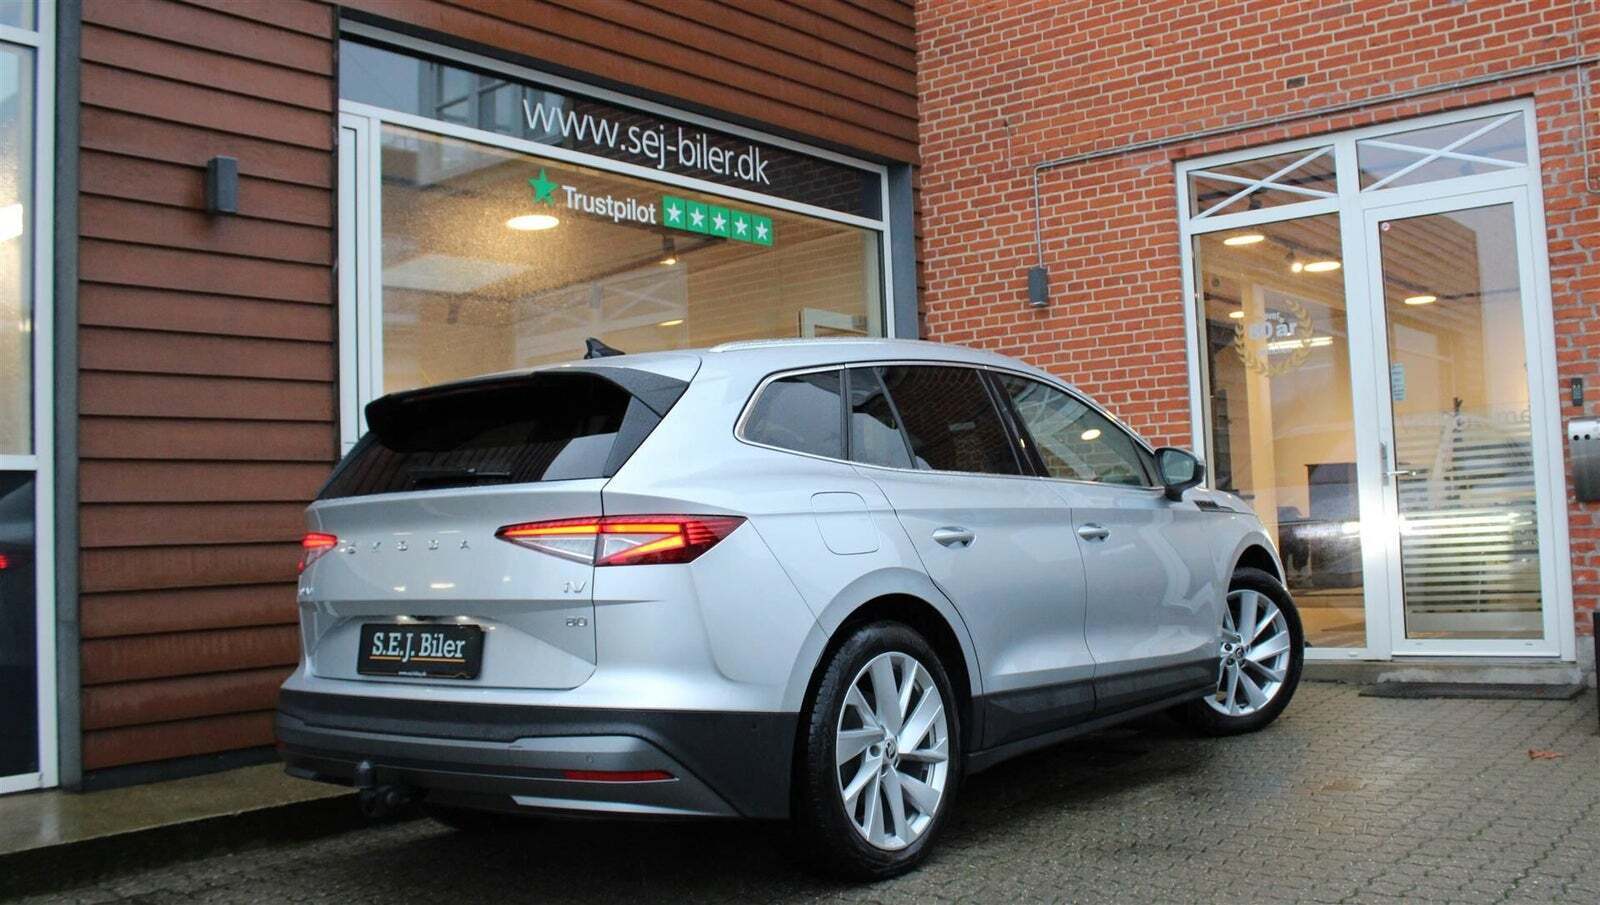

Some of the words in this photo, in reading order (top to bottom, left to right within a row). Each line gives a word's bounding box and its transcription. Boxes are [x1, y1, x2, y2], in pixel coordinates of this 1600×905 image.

[523, 99, 770, 185] www.sej-biler.dk
[561, 184, 657, 225] Trustpilot
[566, 617, 588, 628] 80
[371, 631, 415, 663] S.E.J.
[418, 632, 466, 659] Biler
